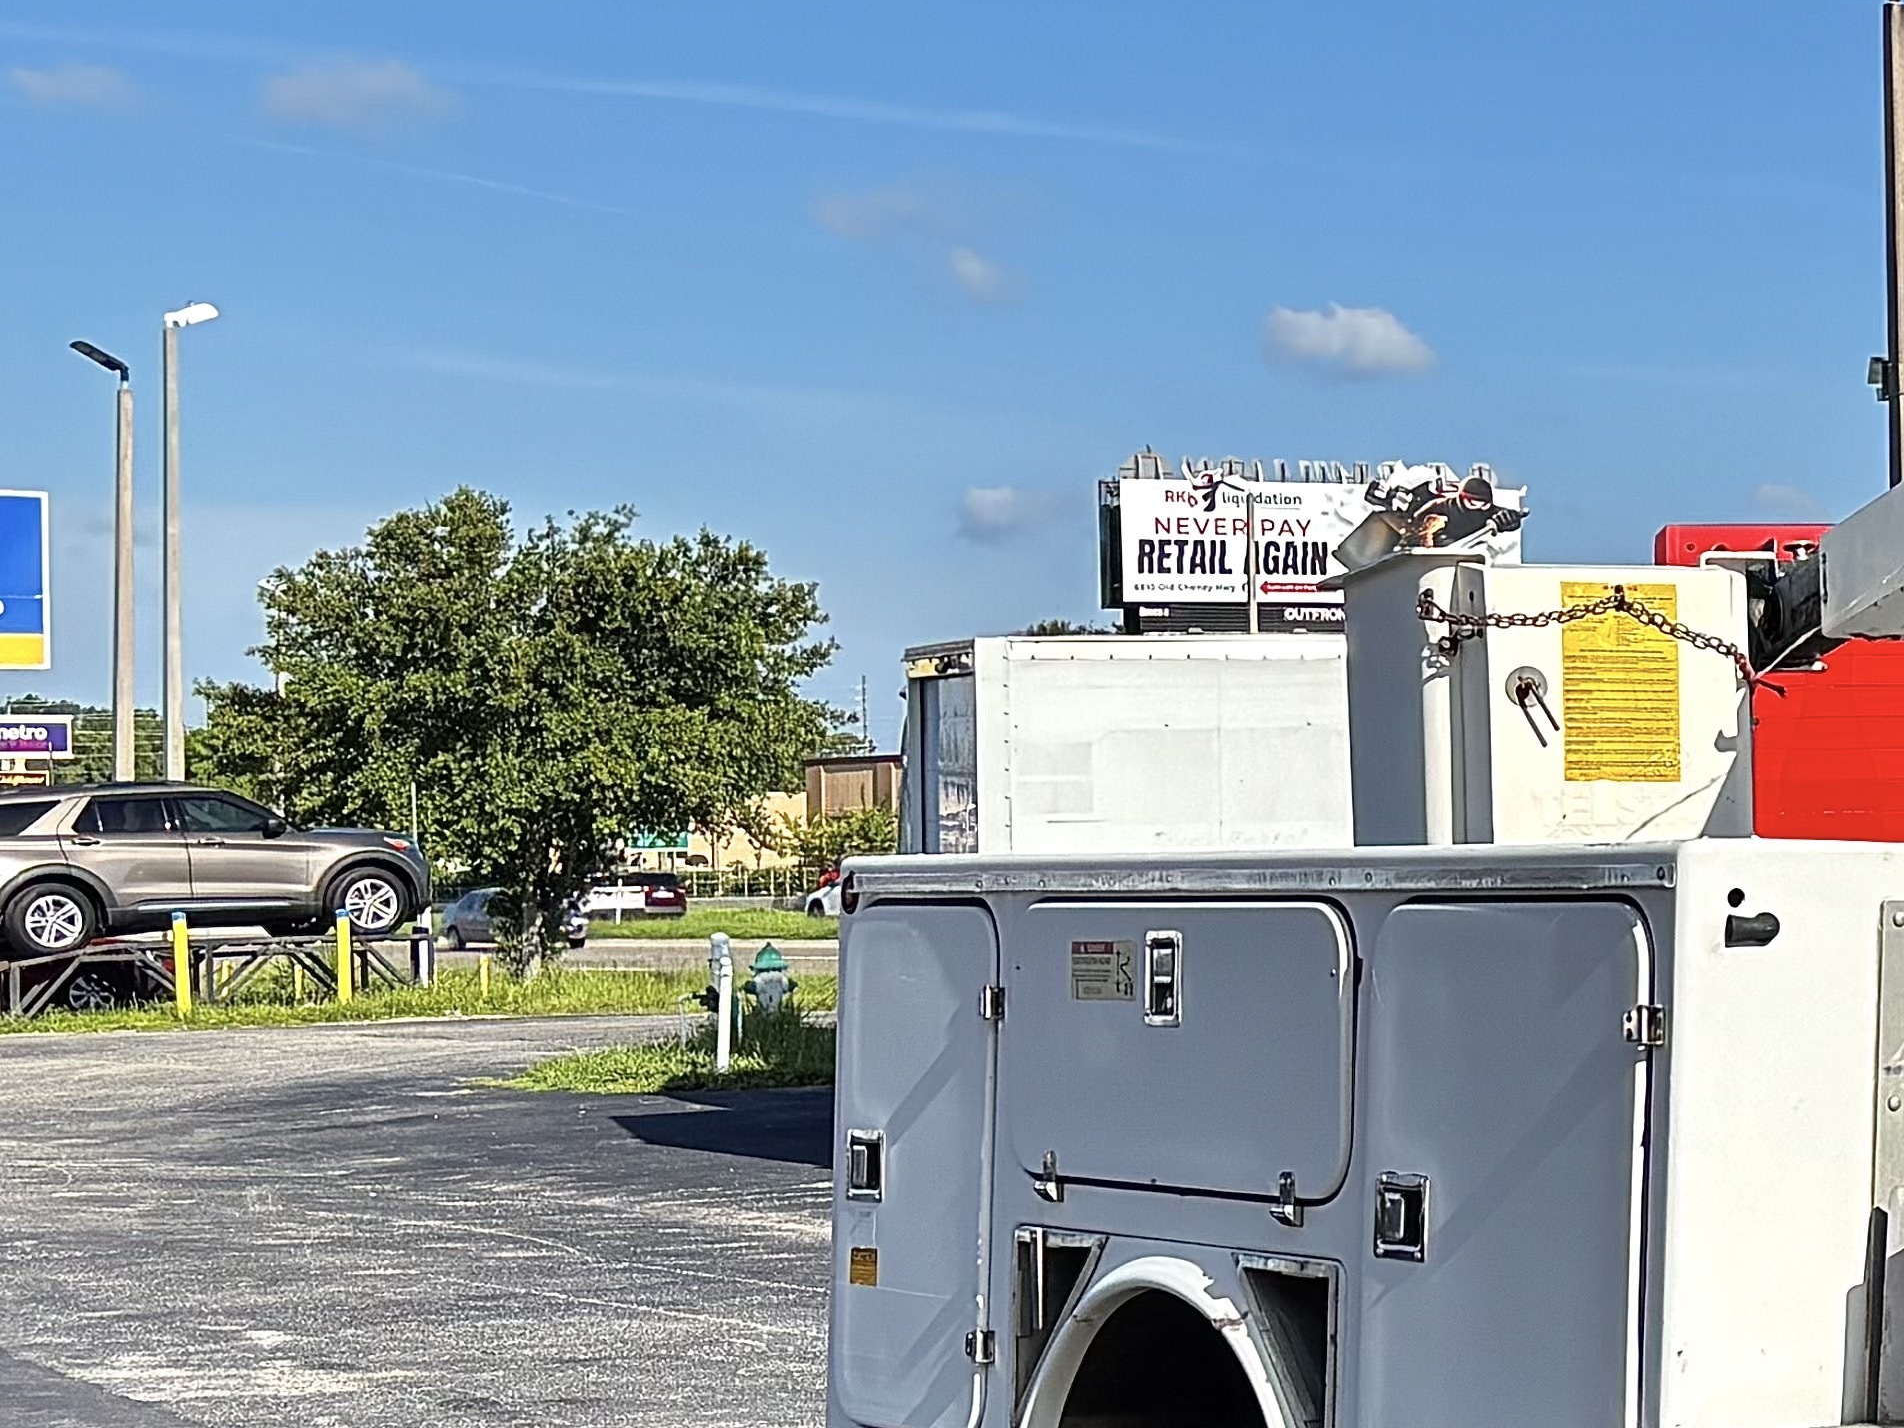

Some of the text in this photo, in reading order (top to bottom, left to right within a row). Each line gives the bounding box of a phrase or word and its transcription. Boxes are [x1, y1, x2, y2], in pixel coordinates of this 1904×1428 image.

[1222, 491, 1303, 508] liqudation
[1155, 517, 1311, 537] NEVER PAY
[1138, 539, 1233, 575] RETAIL
[1283, 606, 1346, 621] OUTFRON
